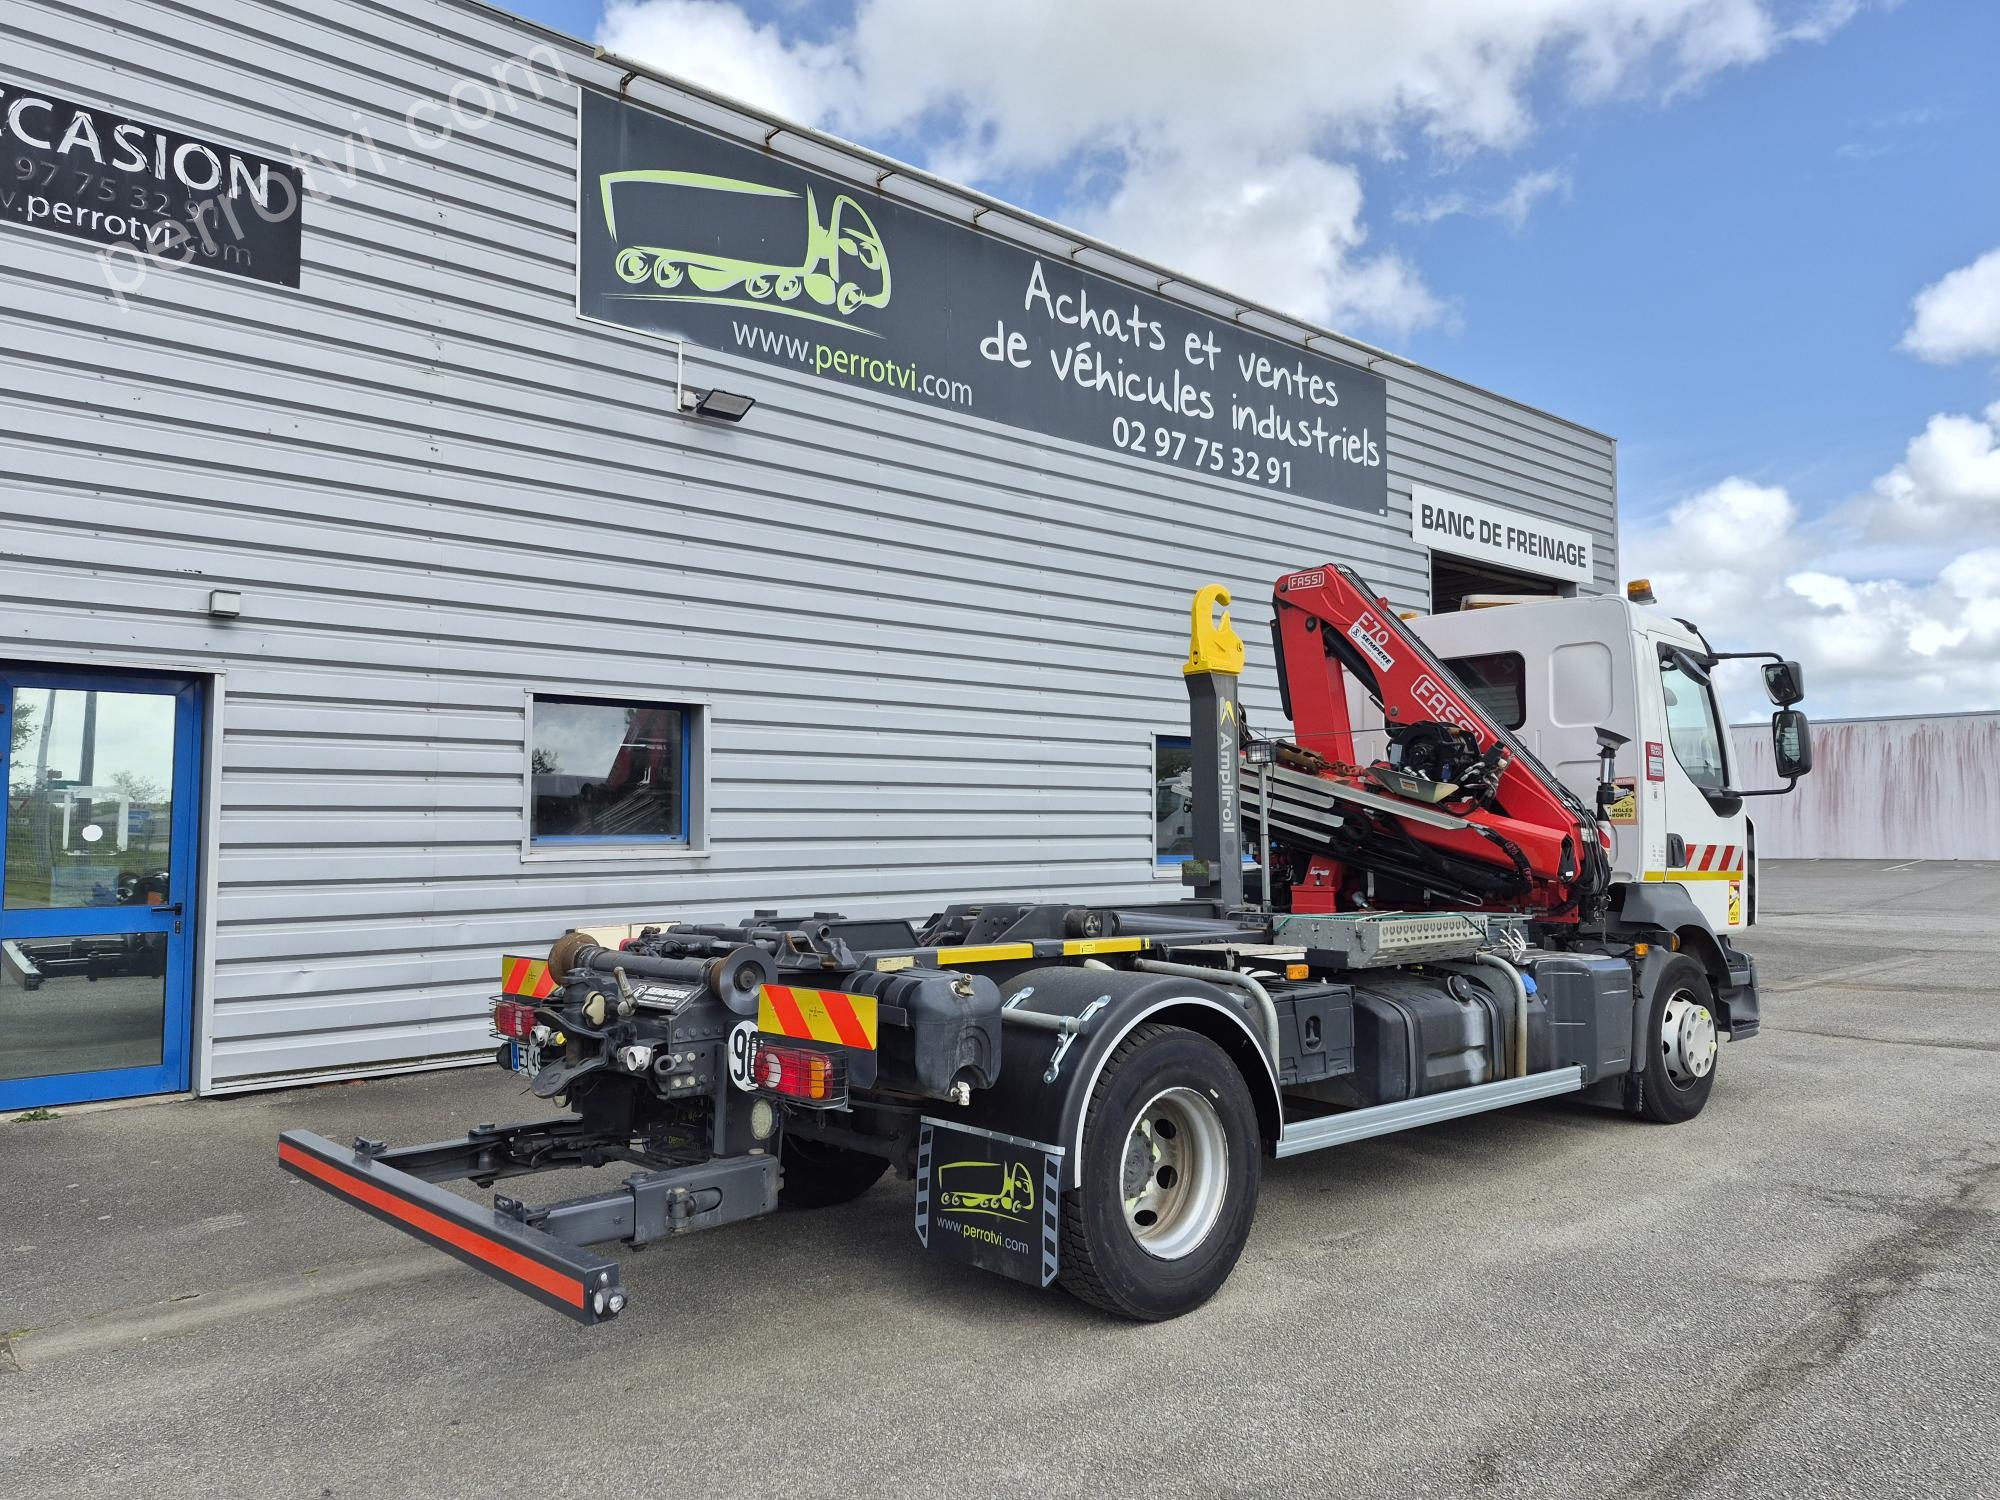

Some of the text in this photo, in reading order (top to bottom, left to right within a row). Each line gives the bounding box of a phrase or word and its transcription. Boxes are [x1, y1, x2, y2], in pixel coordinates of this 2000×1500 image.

[0, 88, 269, 208] CASION
[733, 321, 973, 406] www.perrotvi.com
[1024, 260, 1339, 407] Achats et ventes
[980, 320, 1381, 467] de véhicules industriels
[1112, 416, 1291, 489] 02 97 75 32 91
[1421, 503, 1587, 569] BANC DE FREINAGE
[1291, 574, 1321, 587] FASSI
[1357, 611, 1391, 647] F70
[1360, 633, 1392, 665] SEMPERE
[1219, 731, 1235, 833] Ampliroll
[936, 1216, 1029, 1255] www.perrotvi.com
